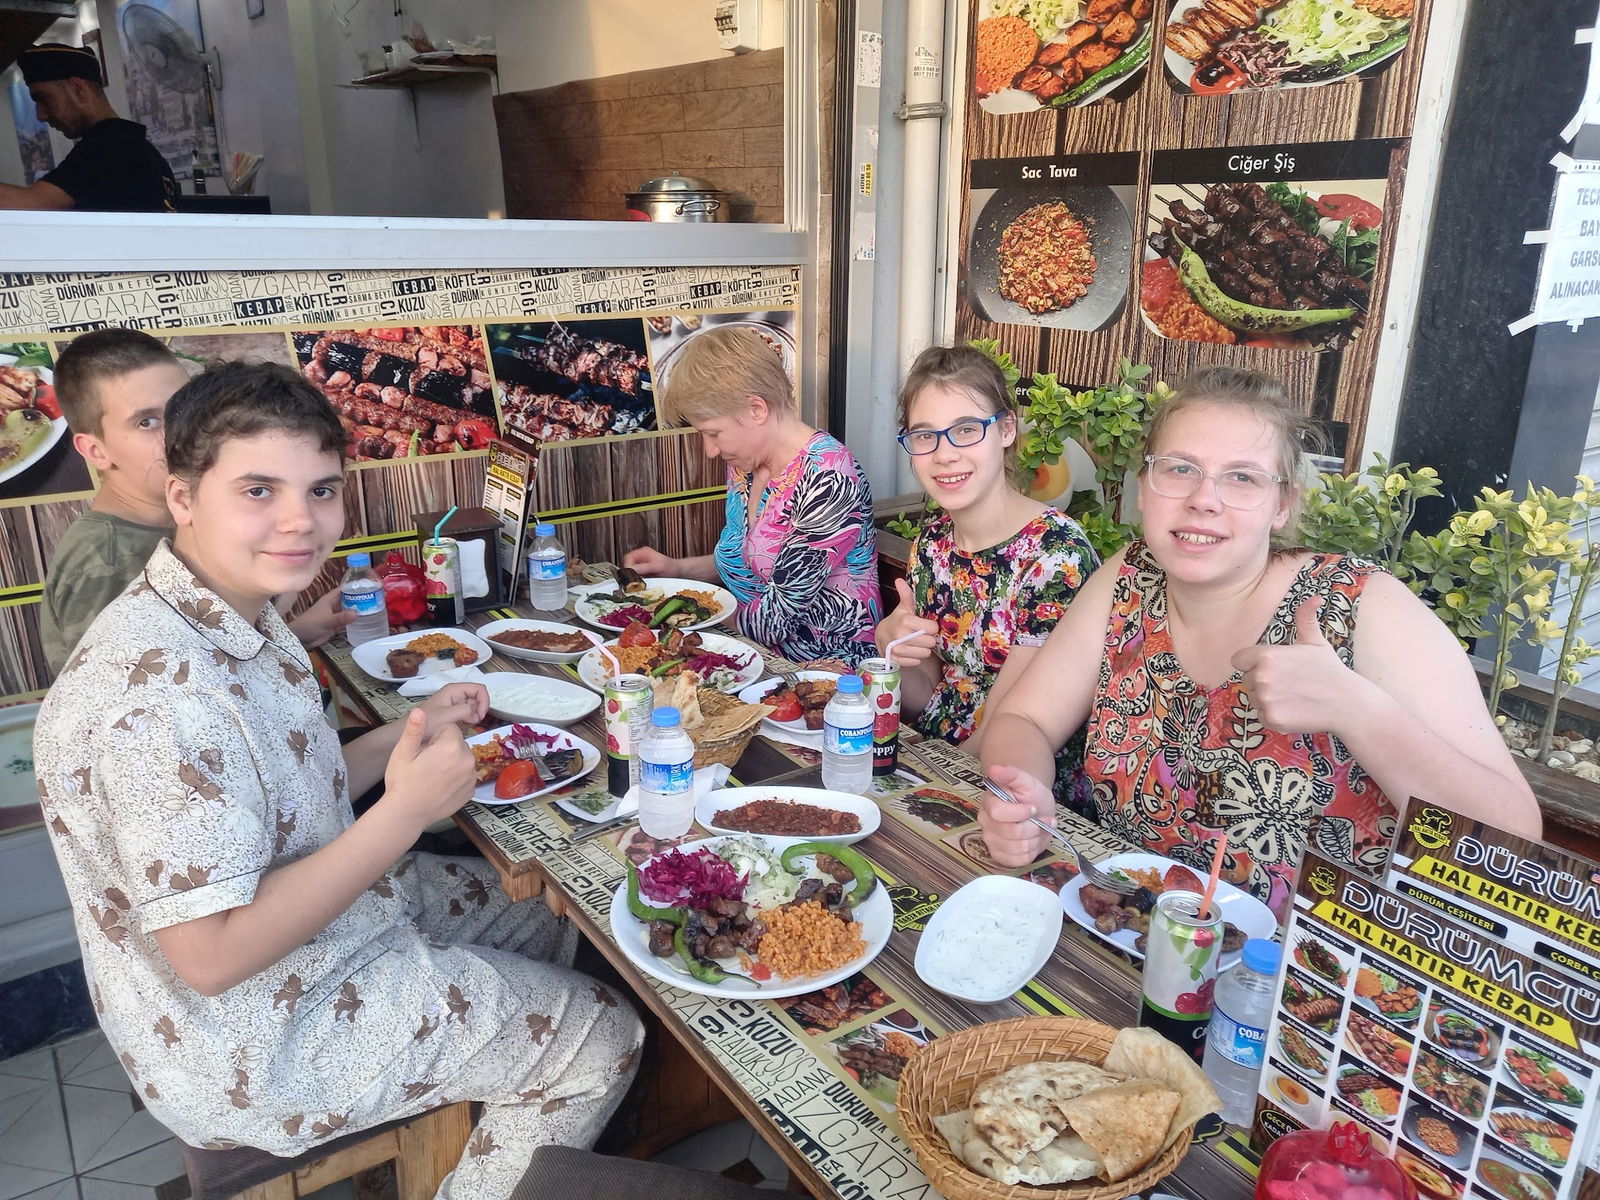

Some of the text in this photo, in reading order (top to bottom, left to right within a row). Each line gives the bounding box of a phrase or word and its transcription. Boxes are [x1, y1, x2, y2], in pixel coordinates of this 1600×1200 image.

[1021, 164, 1078, 179] Sac Tava
[1228, 152, 1296, 174] Ciğer Şiş
[56, 282, 97, 301] DÜRÜM
[393, 277, 436, 296] KEBAP
[444, 273, 477, 289] KÖFTE
[690, 283, 721, 299] KEBAP
[60, 291, 160, 324] IZGARA
[235, 298, 283, 318] KEBAP
[294, 292, 332, 311] KÖFTE
[508, 819, 551, 847] KÖFTE
[1430, 861, 1472, 892] HAL
[1477, 881, 1550, 925] HATIR
[1408, 887, 1495, 932] DÜRÜM ÇEŞİTLERİ
[1342, 880, 1600, 1028] DÜRÜMCÜ
[1550, 951, 1589, 975] ÇORBA
[1331, 907, 1555, 1028] HAL HATIR KEBAP
[740, 1016, 798, 1057] KUZU
[718, 1031, 771, 1072] TAVUK
[773, 1067, 836, 1108] ADANA
[1264, 1120, 1285, 1137] KADA
[1266, 1112, 1286, 1130] GECE
[787, 1093, 931, 1200] IZGARA
